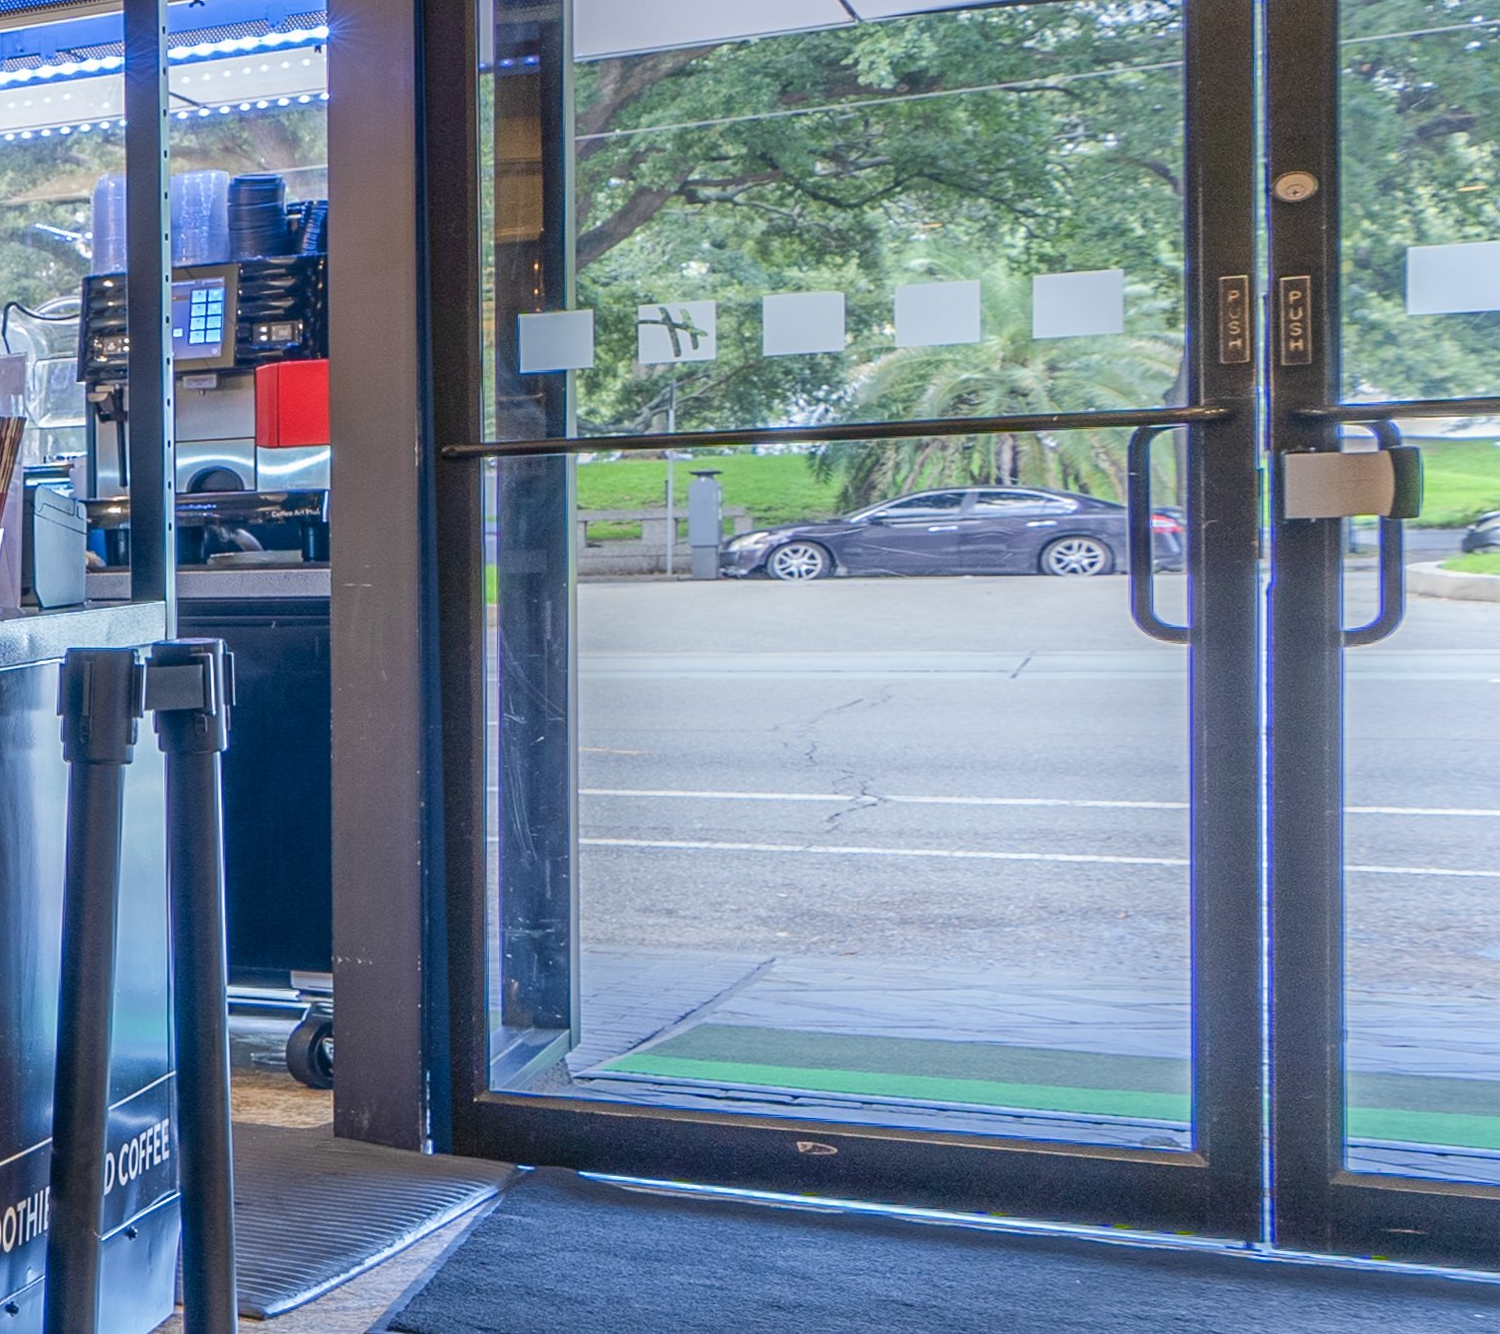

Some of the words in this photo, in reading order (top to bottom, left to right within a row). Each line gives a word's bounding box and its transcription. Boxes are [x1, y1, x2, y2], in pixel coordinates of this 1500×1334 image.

[1227, 289, 1242, 350] PUSH
[1288, 290, 1304, 351] PUSH
[118, 1118, 170, 1187] COFFEE
